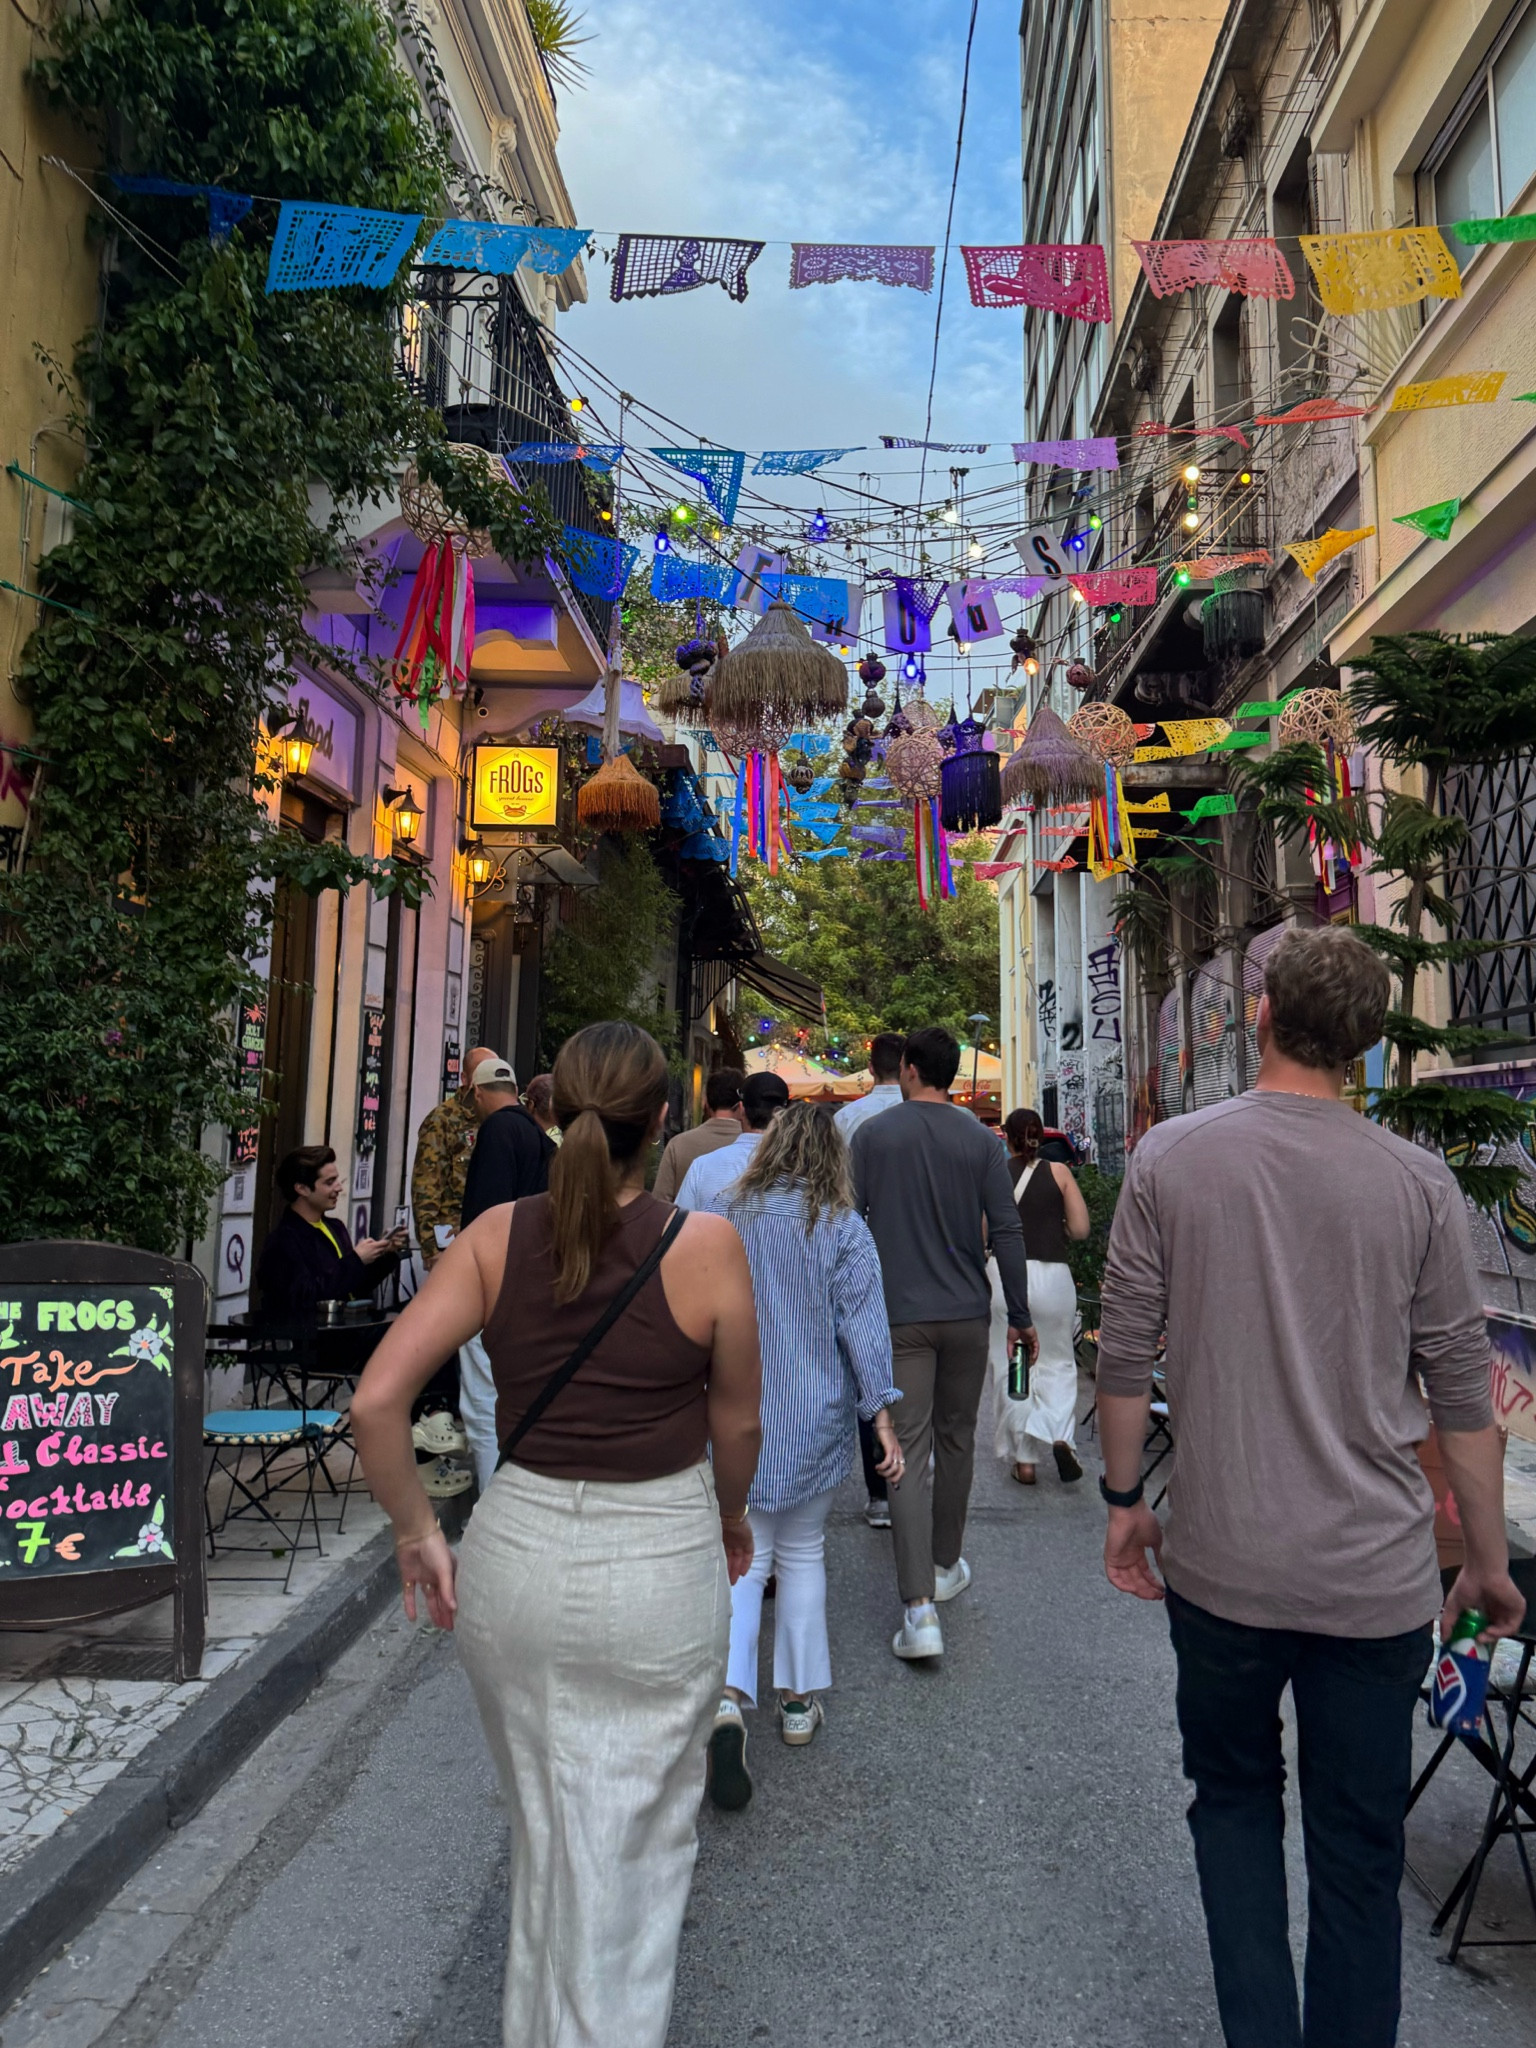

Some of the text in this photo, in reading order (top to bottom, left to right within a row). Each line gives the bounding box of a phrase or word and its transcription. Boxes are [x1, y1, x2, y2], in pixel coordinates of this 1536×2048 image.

[490, 760, 544, 794] FROGS
[0, 1299, 136, 1332] HE FROGS
[0, 1350, 139, 1393] Take
[1, 1392, 120, 1431] AWAY
[36, 1431, 168, 1467] Classic
[0, 1478, 151, 1519] ocktails
[15, 1522, 50, 1564] 7
